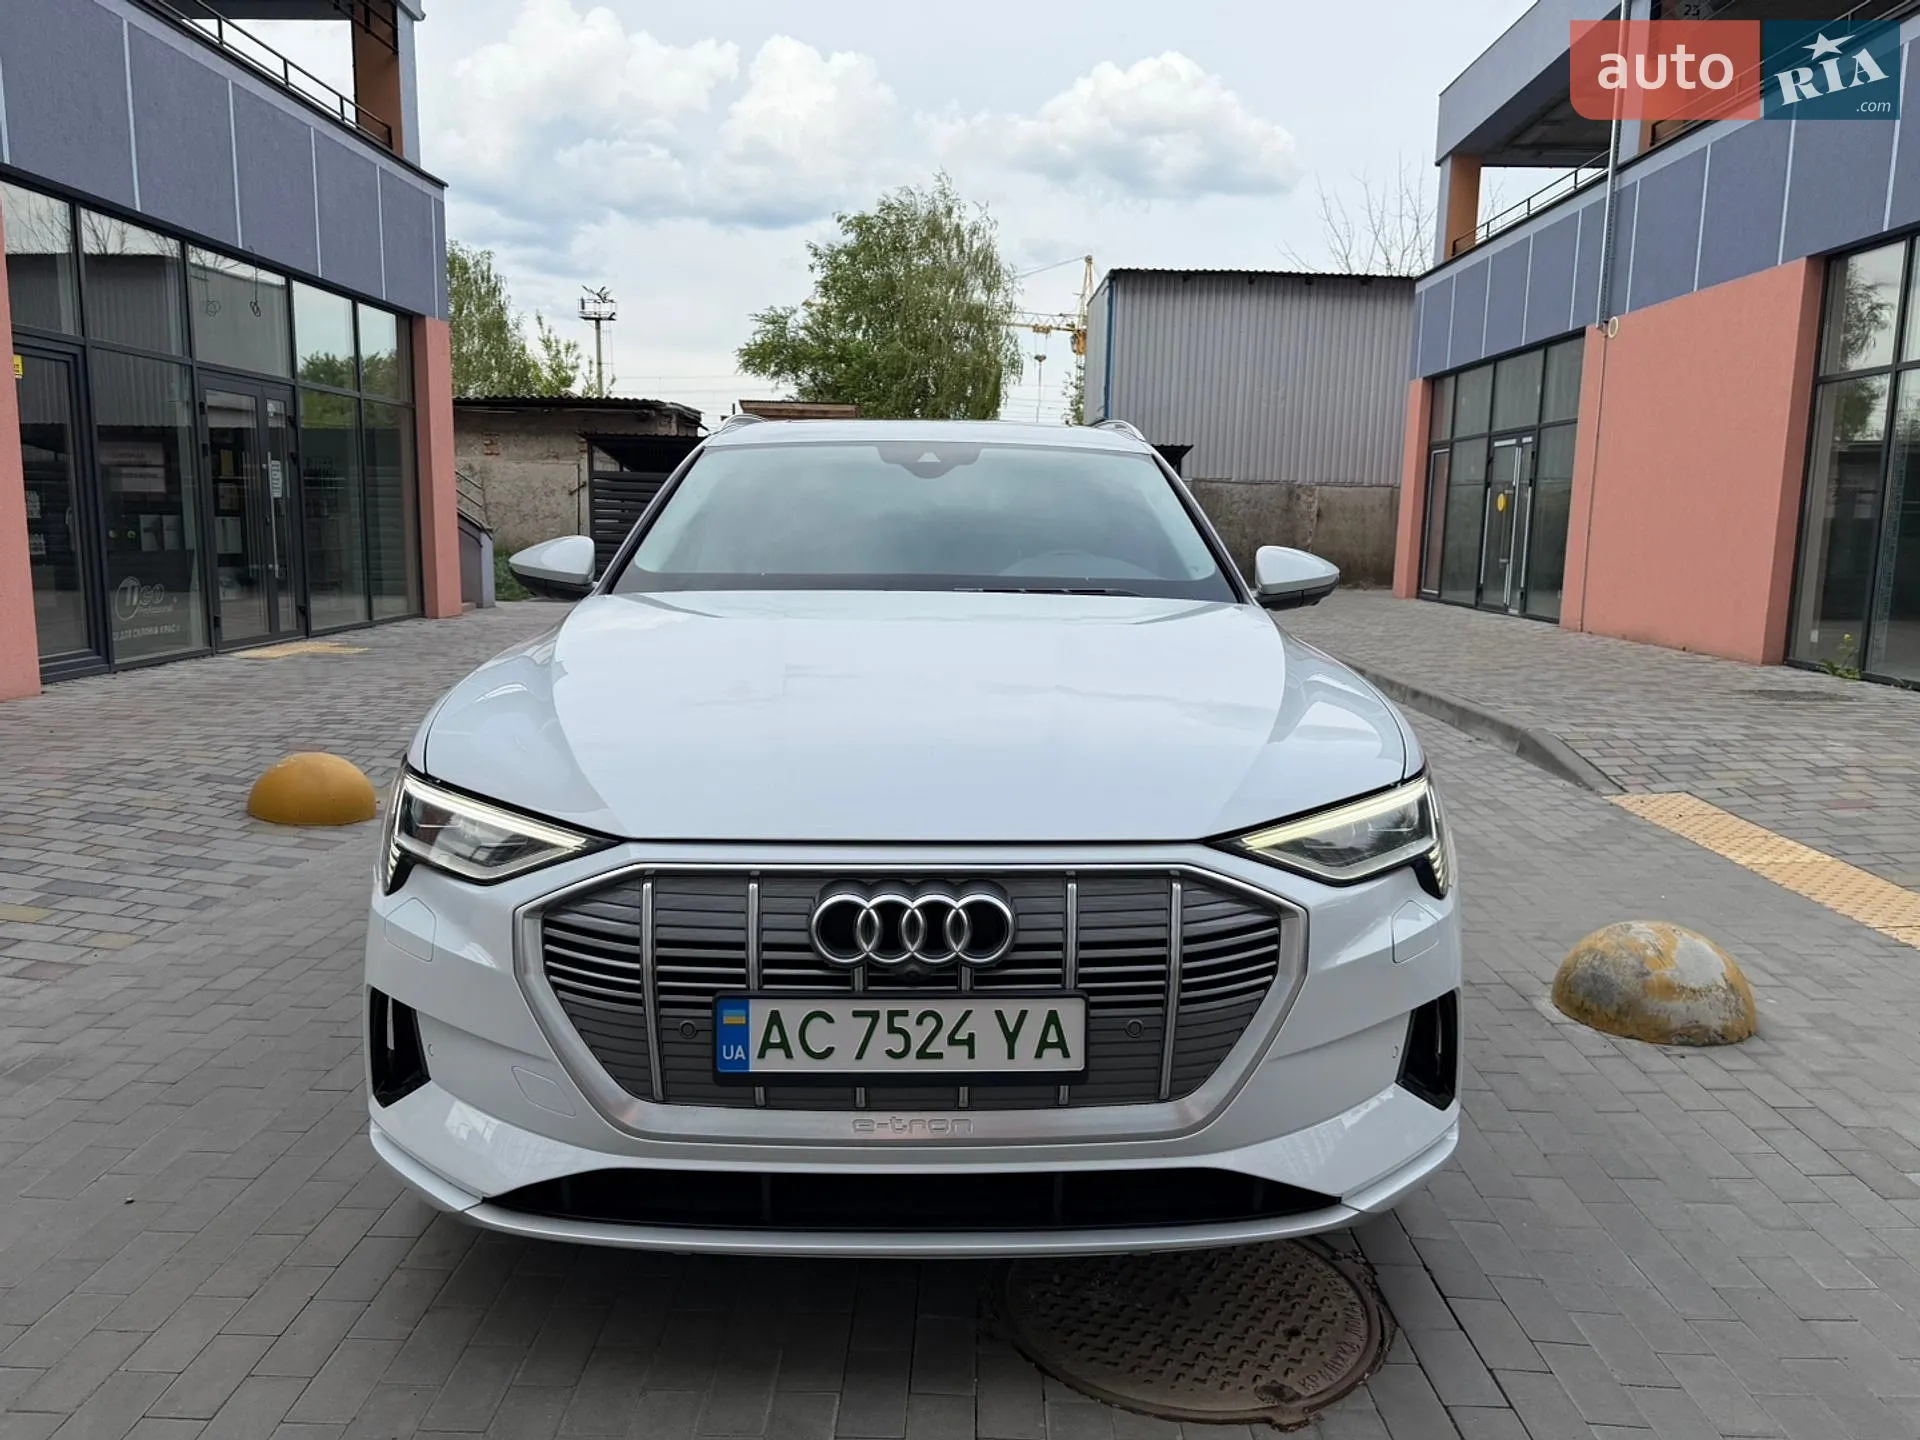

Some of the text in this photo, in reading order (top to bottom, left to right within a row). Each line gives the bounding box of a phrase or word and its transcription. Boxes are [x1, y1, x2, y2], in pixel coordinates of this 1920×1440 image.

[722, 1009, 1071, 1060] UA AC 7524 YA
[852, 1115, 974, 1135] e-tron
